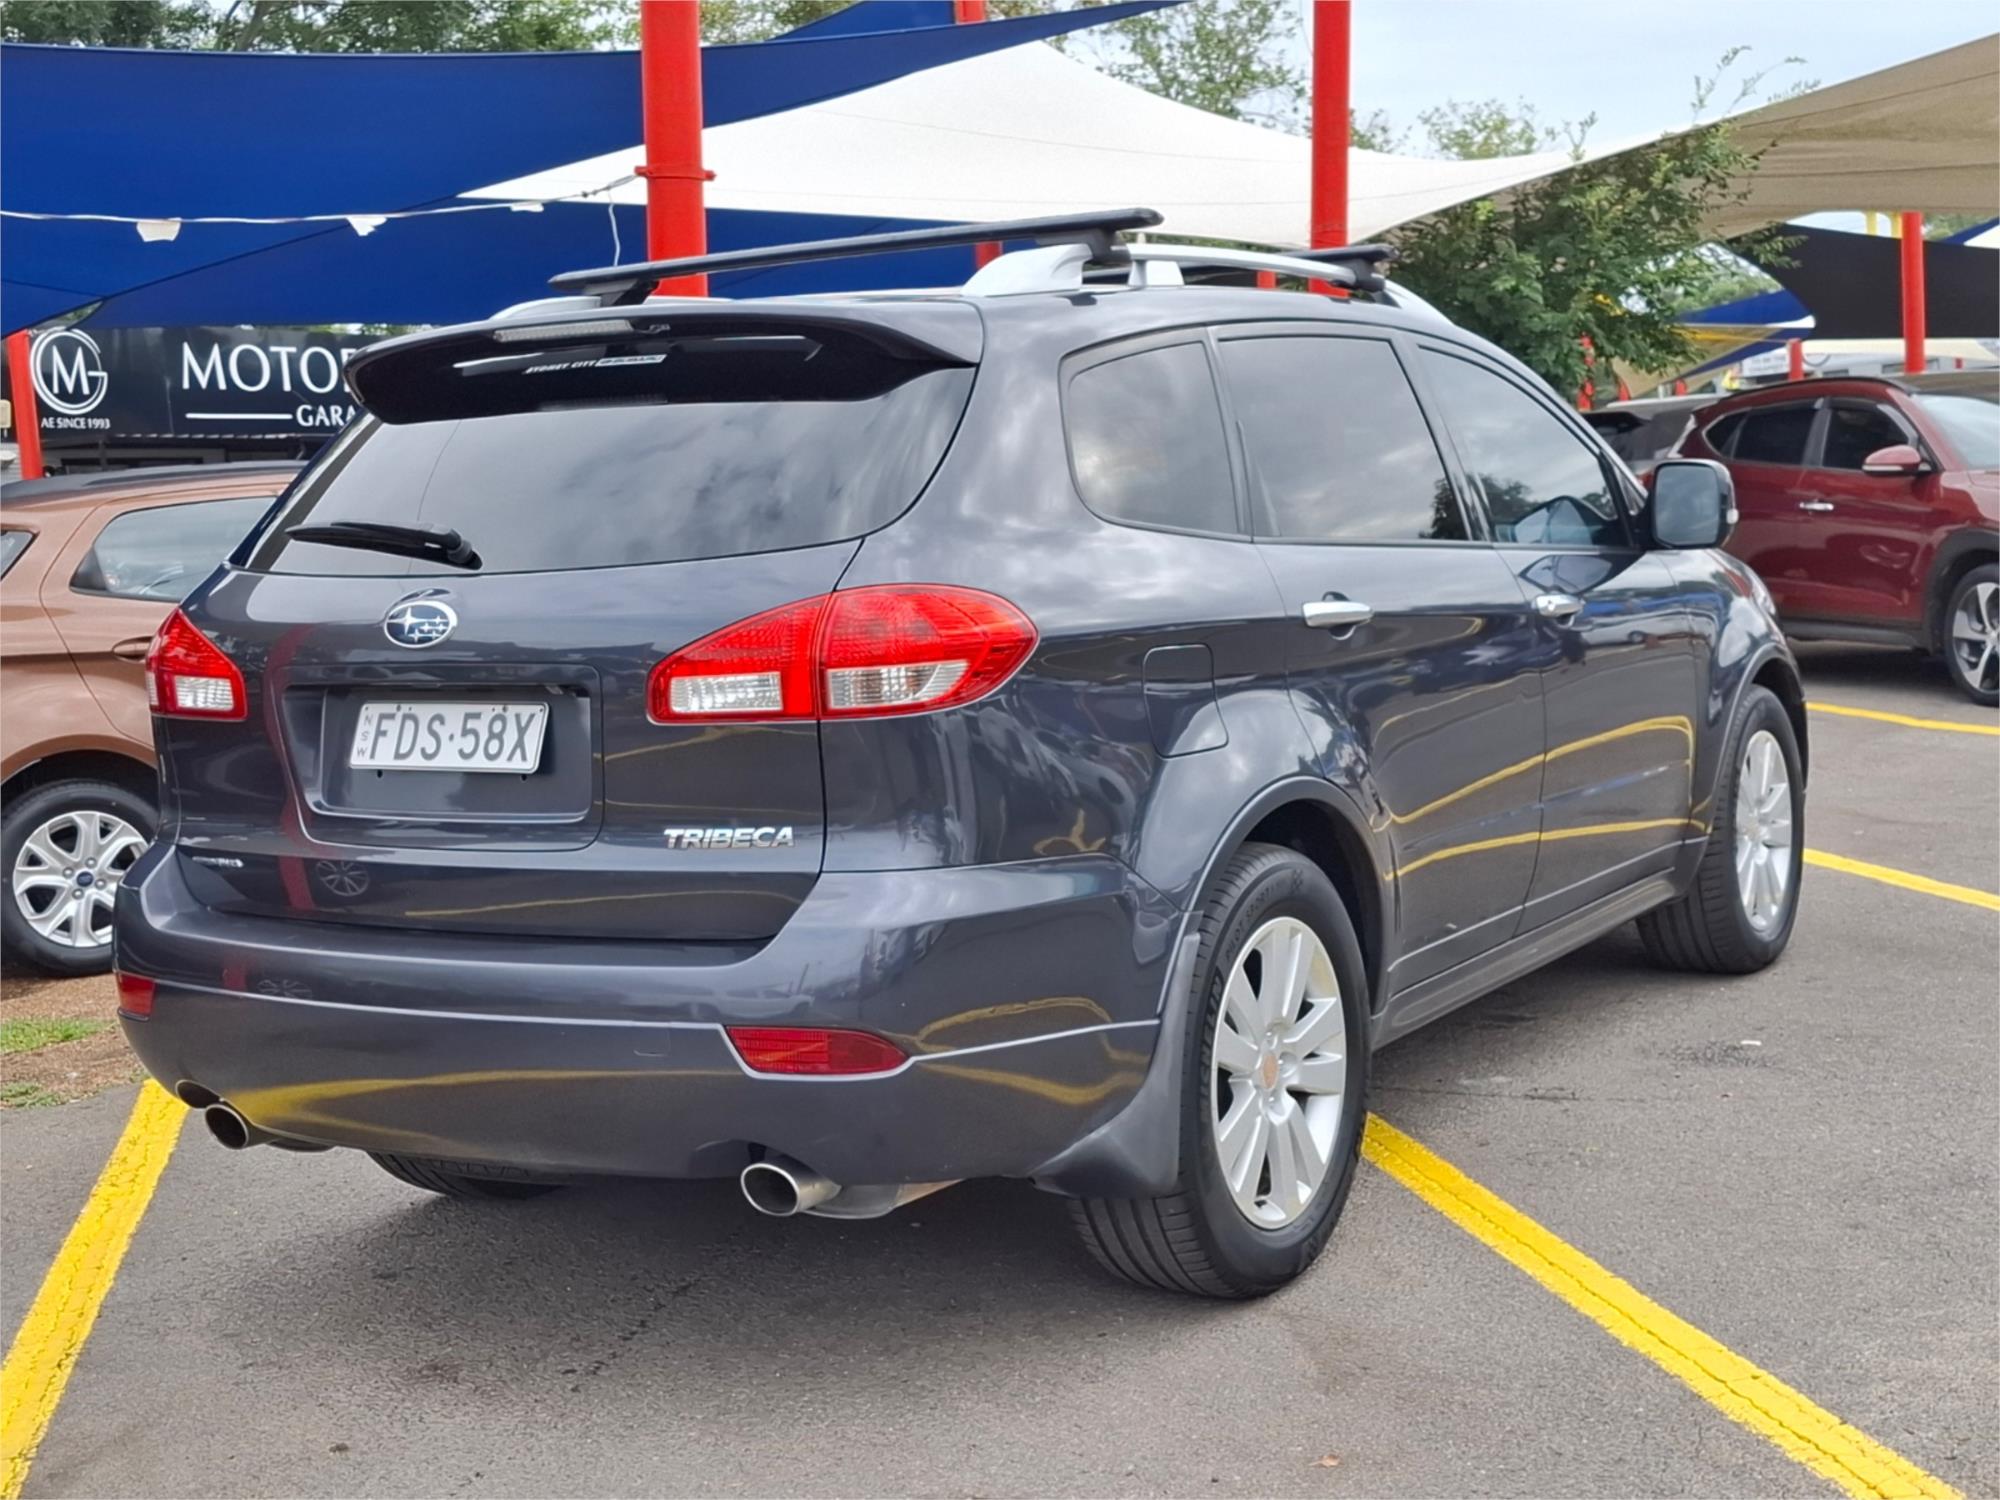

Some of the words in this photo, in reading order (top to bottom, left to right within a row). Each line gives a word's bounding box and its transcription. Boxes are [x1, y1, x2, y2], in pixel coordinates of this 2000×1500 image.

[56, 417, 86, 429] SINCE
[87, 417, 111, 429] 1993
[664, 826, 795, 849] TRIBECA
